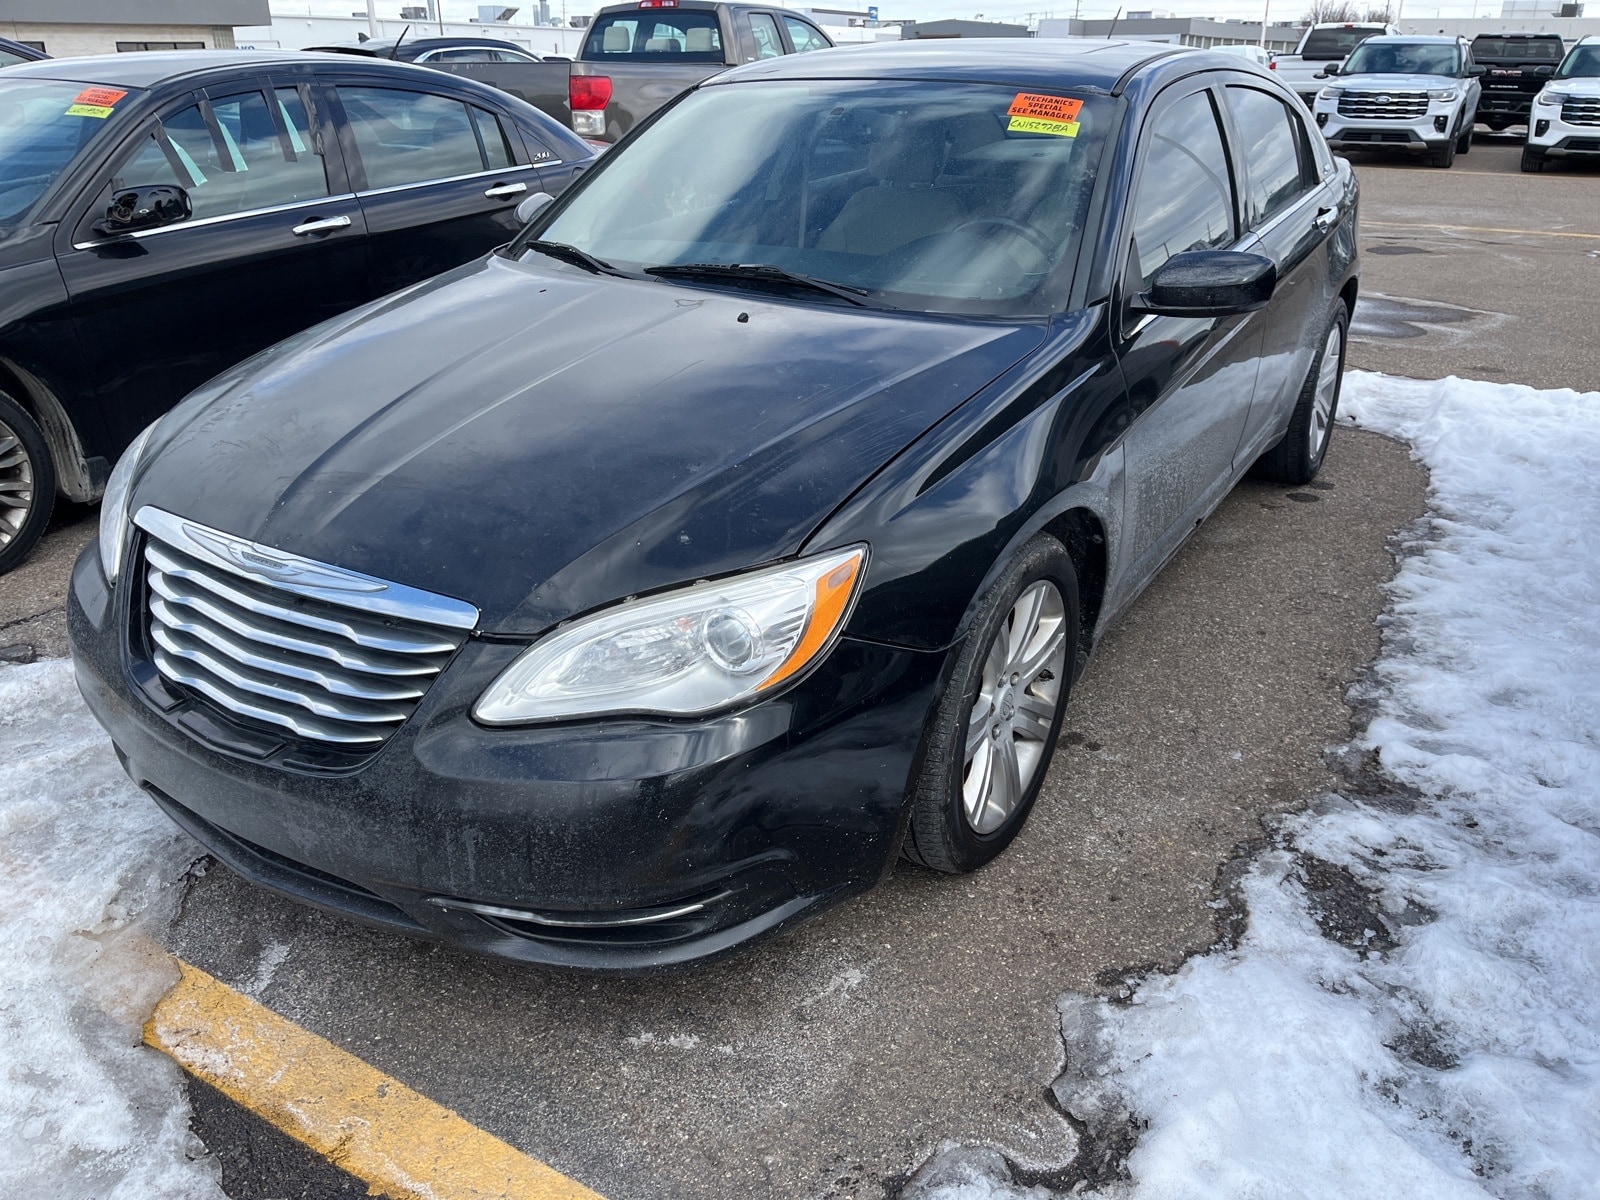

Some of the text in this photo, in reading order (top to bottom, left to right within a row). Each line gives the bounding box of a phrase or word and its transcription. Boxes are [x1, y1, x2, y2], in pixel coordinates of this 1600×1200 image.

[1023, 95, 1074, 107] MECHANICS
[1027, 102, 1063, 112] SPECIAL
[1029, 109, 1074, 120] MANAGER
